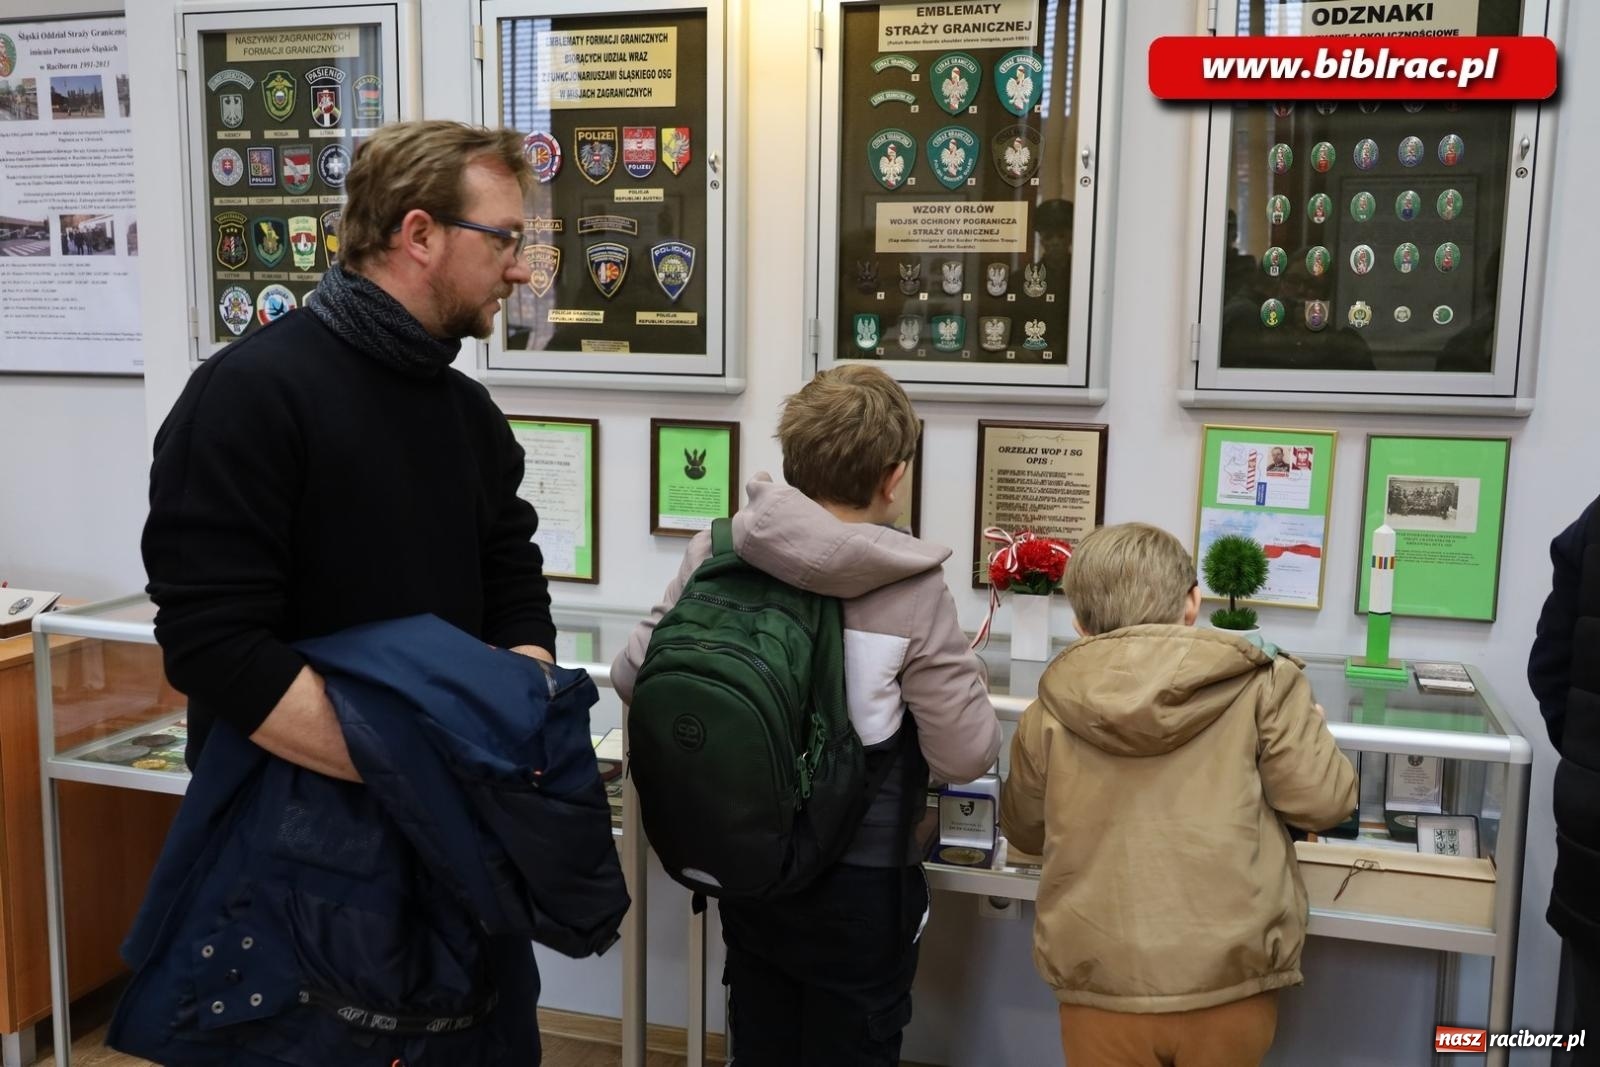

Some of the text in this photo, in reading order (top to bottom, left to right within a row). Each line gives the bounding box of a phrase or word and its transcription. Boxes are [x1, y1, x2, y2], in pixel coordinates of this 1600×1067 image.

[917, 4, 1001, 17] EMBLEMATY
[1312, 3, 1433, 25] ODZNAKI
[885, 21, 1032, 36] STRAŻY GRANICZNEJ
[18, 31, 40, 43] Śląski
[67, 29, 89, 41] Straży
[235, 31, 351, 45] NASZYWKI ZAGRANICZNYCH
[546, 32, 668, 47] EMBLEMATY FORMACJI GRANICZNYCH
[30, 48, 53, 56] imienia
[243, 44, 345, 56] FORMACJI GRANICZNYCH
[564, 51, 648, 66] BIORĄCYCH UDZIAŁ WRAZ
[951, 58, 976, 72] GRANICZNA
[1015, 56, 1041, 71] GRANICZNA
[46, 62, 78, 71] Raciborzu
[308, 68, 342, 82] PASIENIO
[547, 69, 617, 82] FUNKCJONARIUSZAMI
[618, 68, 656, 82] ŚLĄSKIEGO
[657, 69, 672, 79] OSG
[560, 87, 652, 99] W MISJACH ZAGRANICZNYCH
[578, 132, 614, 141] POLIZEI
[948, 130, 973, 145] GRANICZNA
[913, 203, 995, 214] WZORY ORŁÓW
[654, 246, 691, 258] POLICIJA
[998, 446, 1039, 456] ORZEŁKI
[1041, 447, 1062, 456] WOP
[1063, 448, 1068, 456] I
[1026, 457, 1048, 465] OPIS
